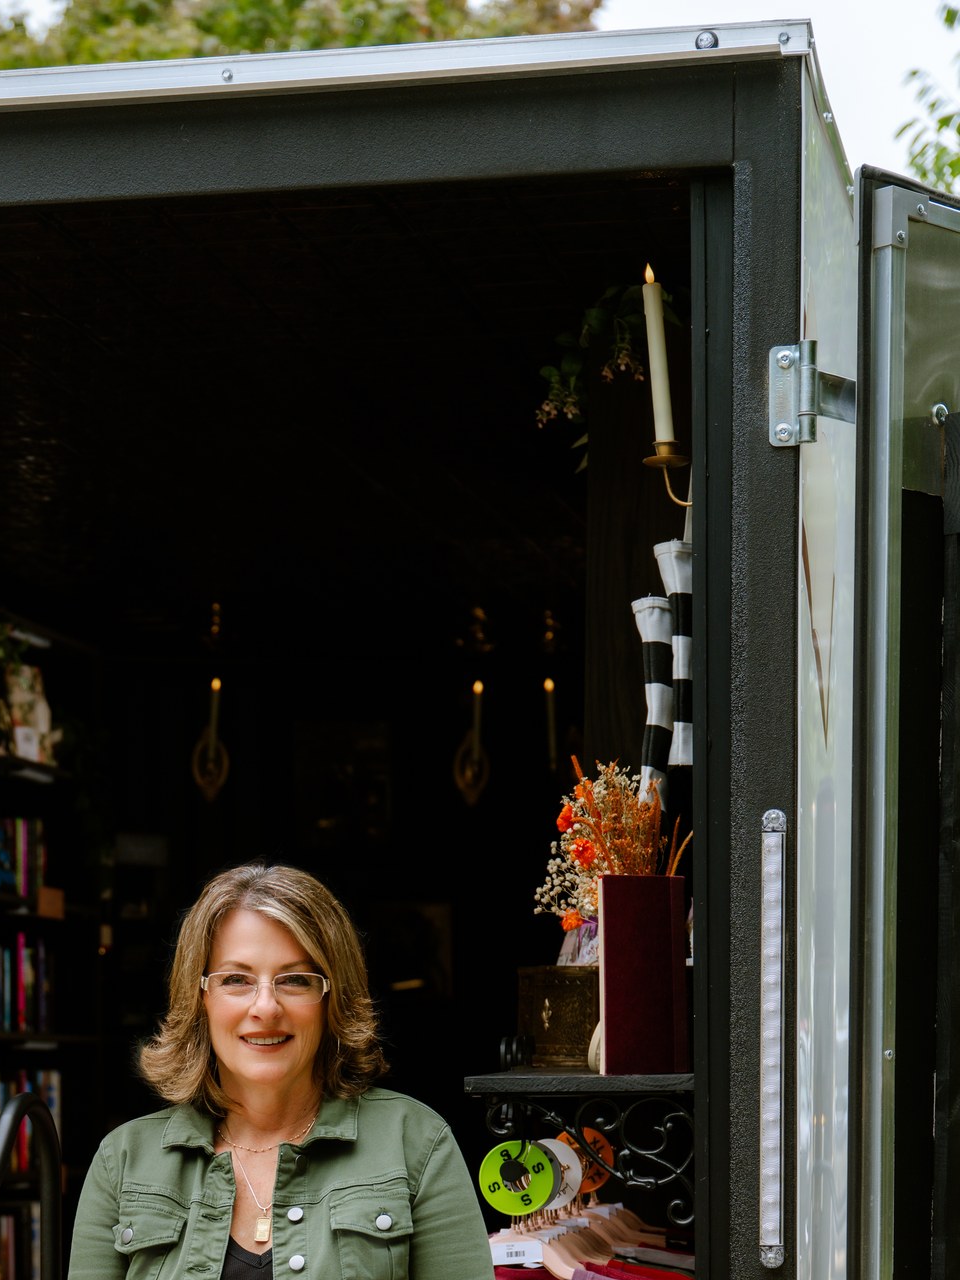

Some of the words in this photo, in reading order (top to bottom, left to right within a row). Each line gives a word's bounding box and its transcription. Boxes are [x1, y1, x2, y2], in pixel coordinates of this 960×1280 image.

[532, 1162, 545, 1174] S
[488, 1181, 501, 1194] S
[520, 1193, 533, 1207] S
